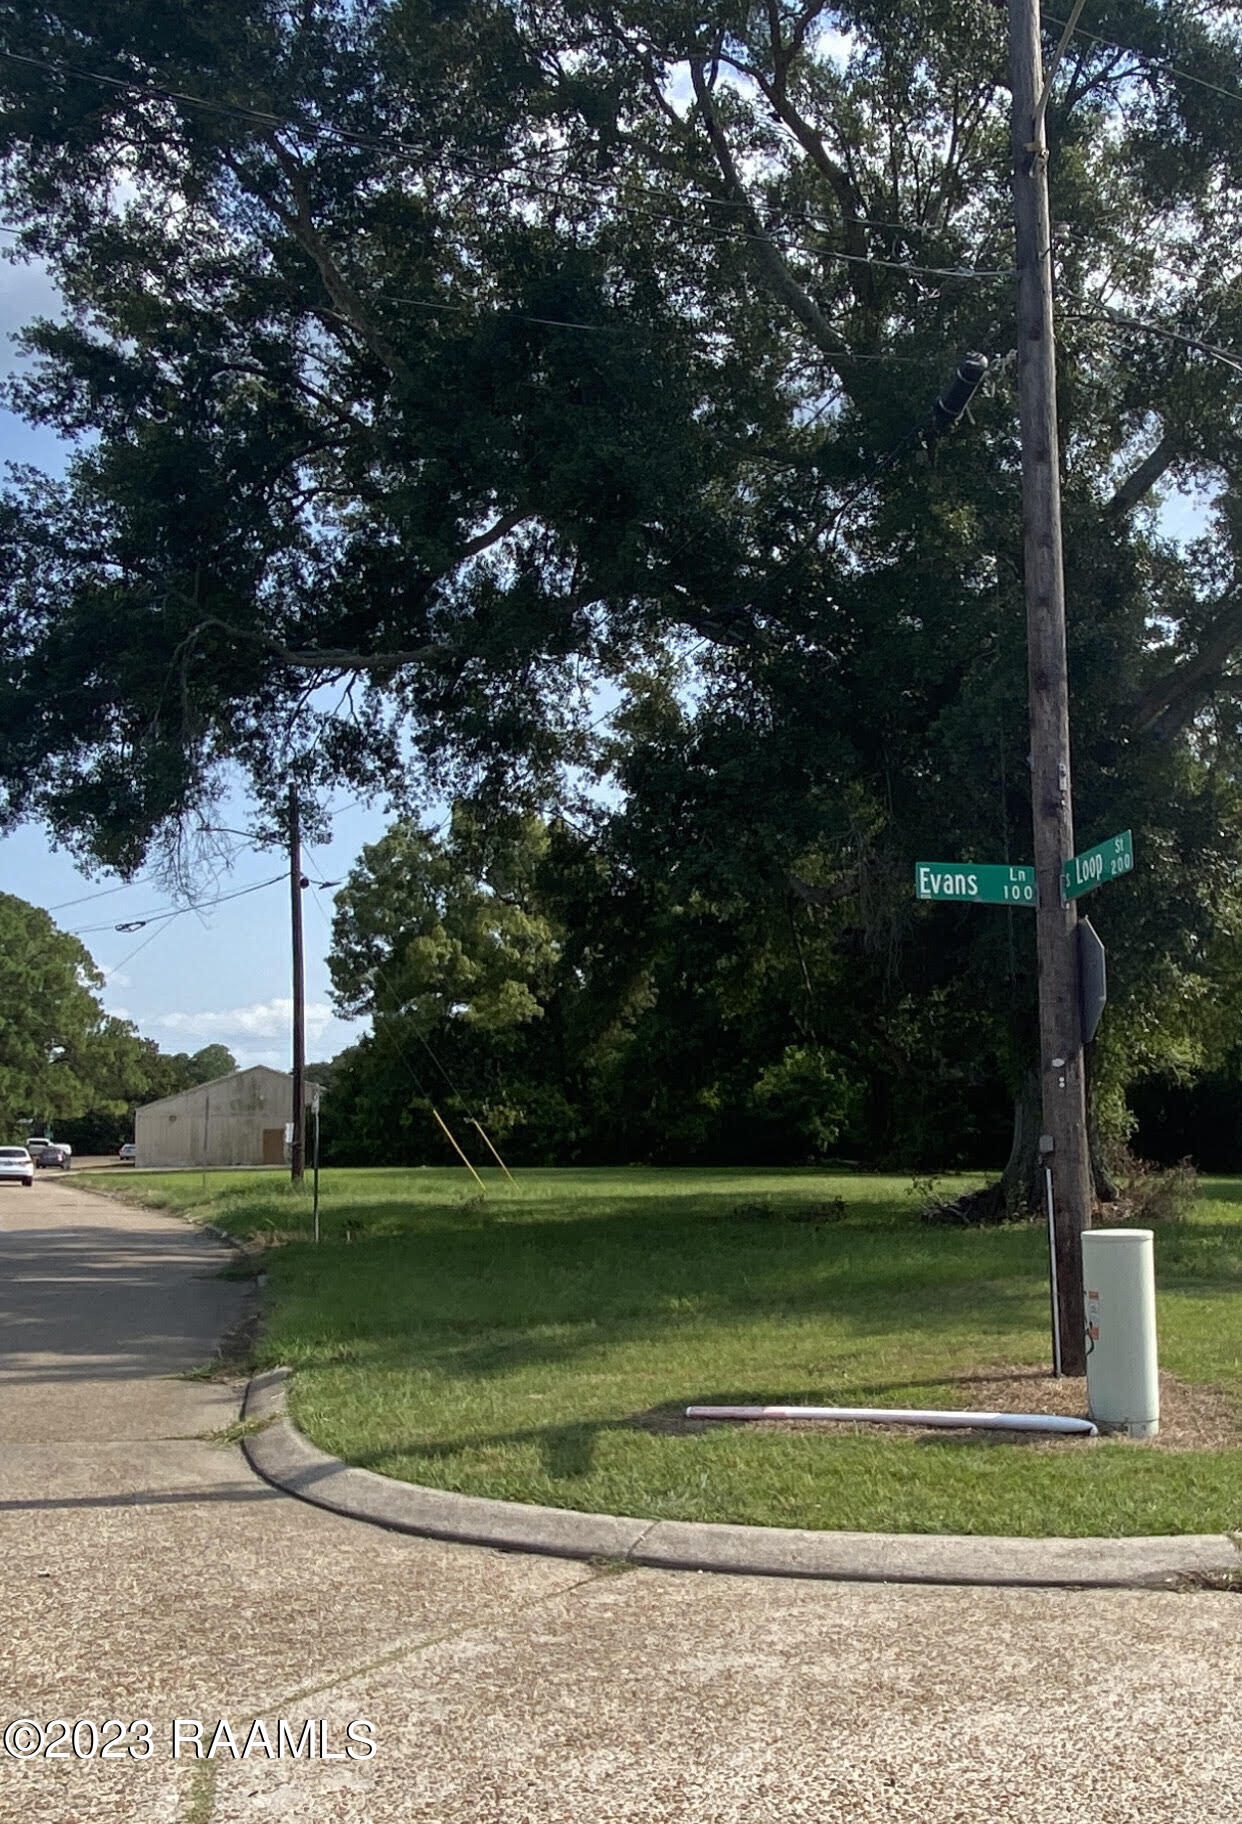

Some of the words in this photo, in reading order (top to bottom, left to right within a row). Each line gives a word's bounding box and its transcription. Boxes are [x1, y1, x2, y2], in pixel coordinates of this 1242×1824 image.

[1076, 853, 1103, 885] Loop
[1114, 838, 1125, 854] St
[1110, 853, 1131, 876] 200
[919, 867, 978, 895] Evans
[1009, 867, 1026, 881] Ln
[1003, 885, 1033, 900] 100
